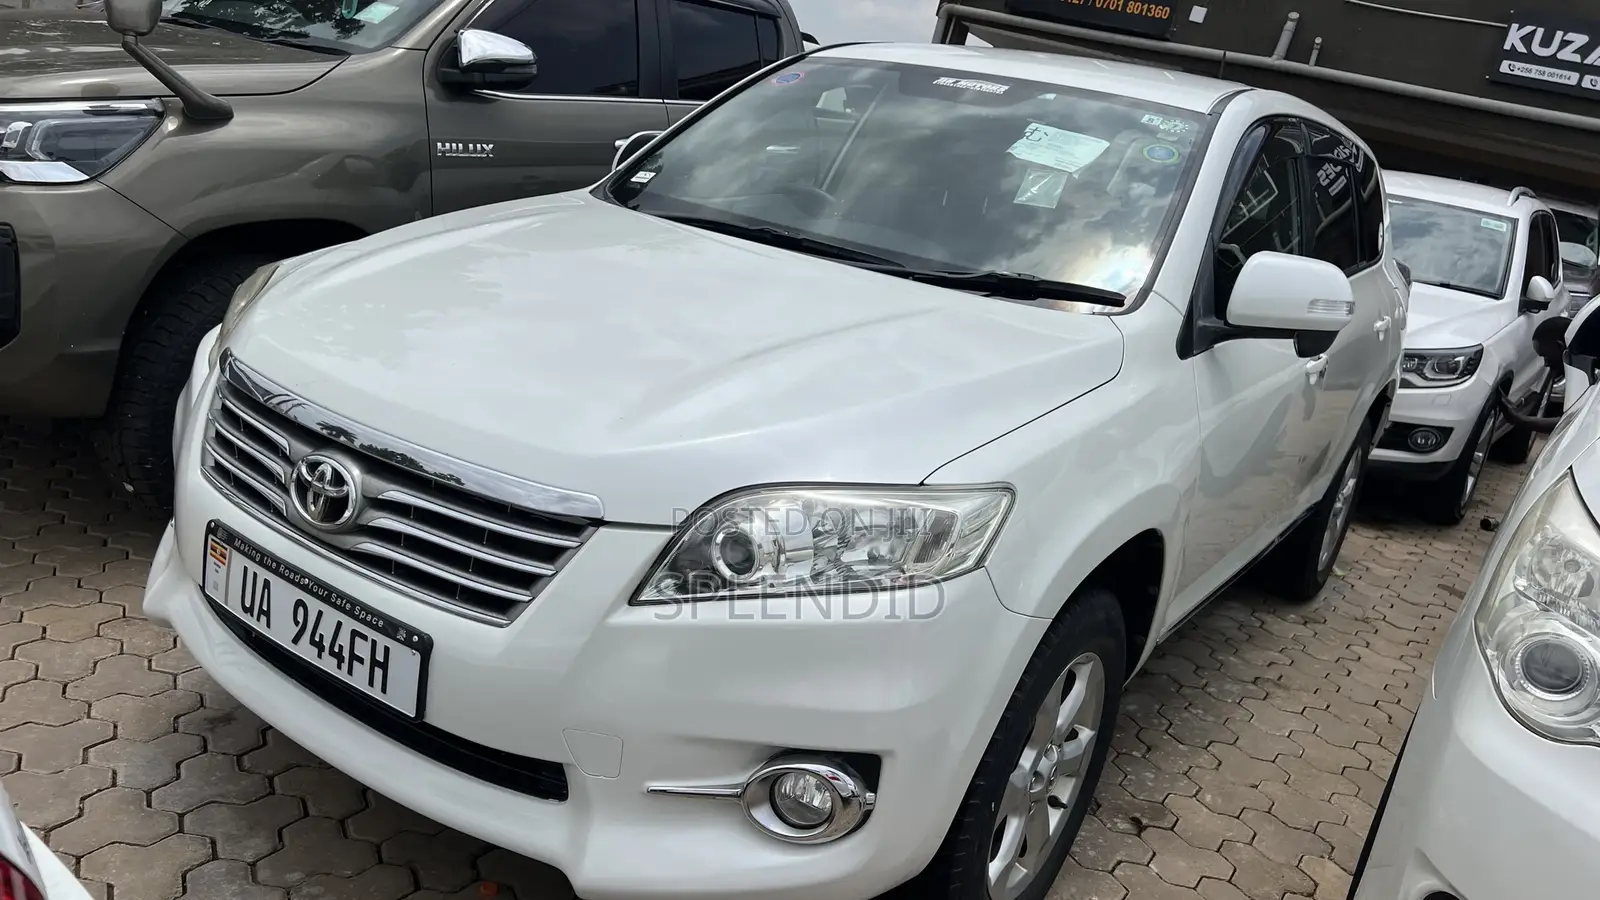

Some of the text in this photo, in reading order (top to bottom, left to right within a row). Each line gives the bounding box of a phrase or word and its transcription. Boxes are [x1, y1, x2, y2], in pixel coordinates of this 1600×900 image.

[1126, 1, 1170, 19] 801360
[1517, 66, 1532, 74] +256
[437, 142, 494, 157] HILUX
[234, 537, 384, 628] Making the Roads Your Safe Space
[241, 565, 390, 695] UA 944FH
